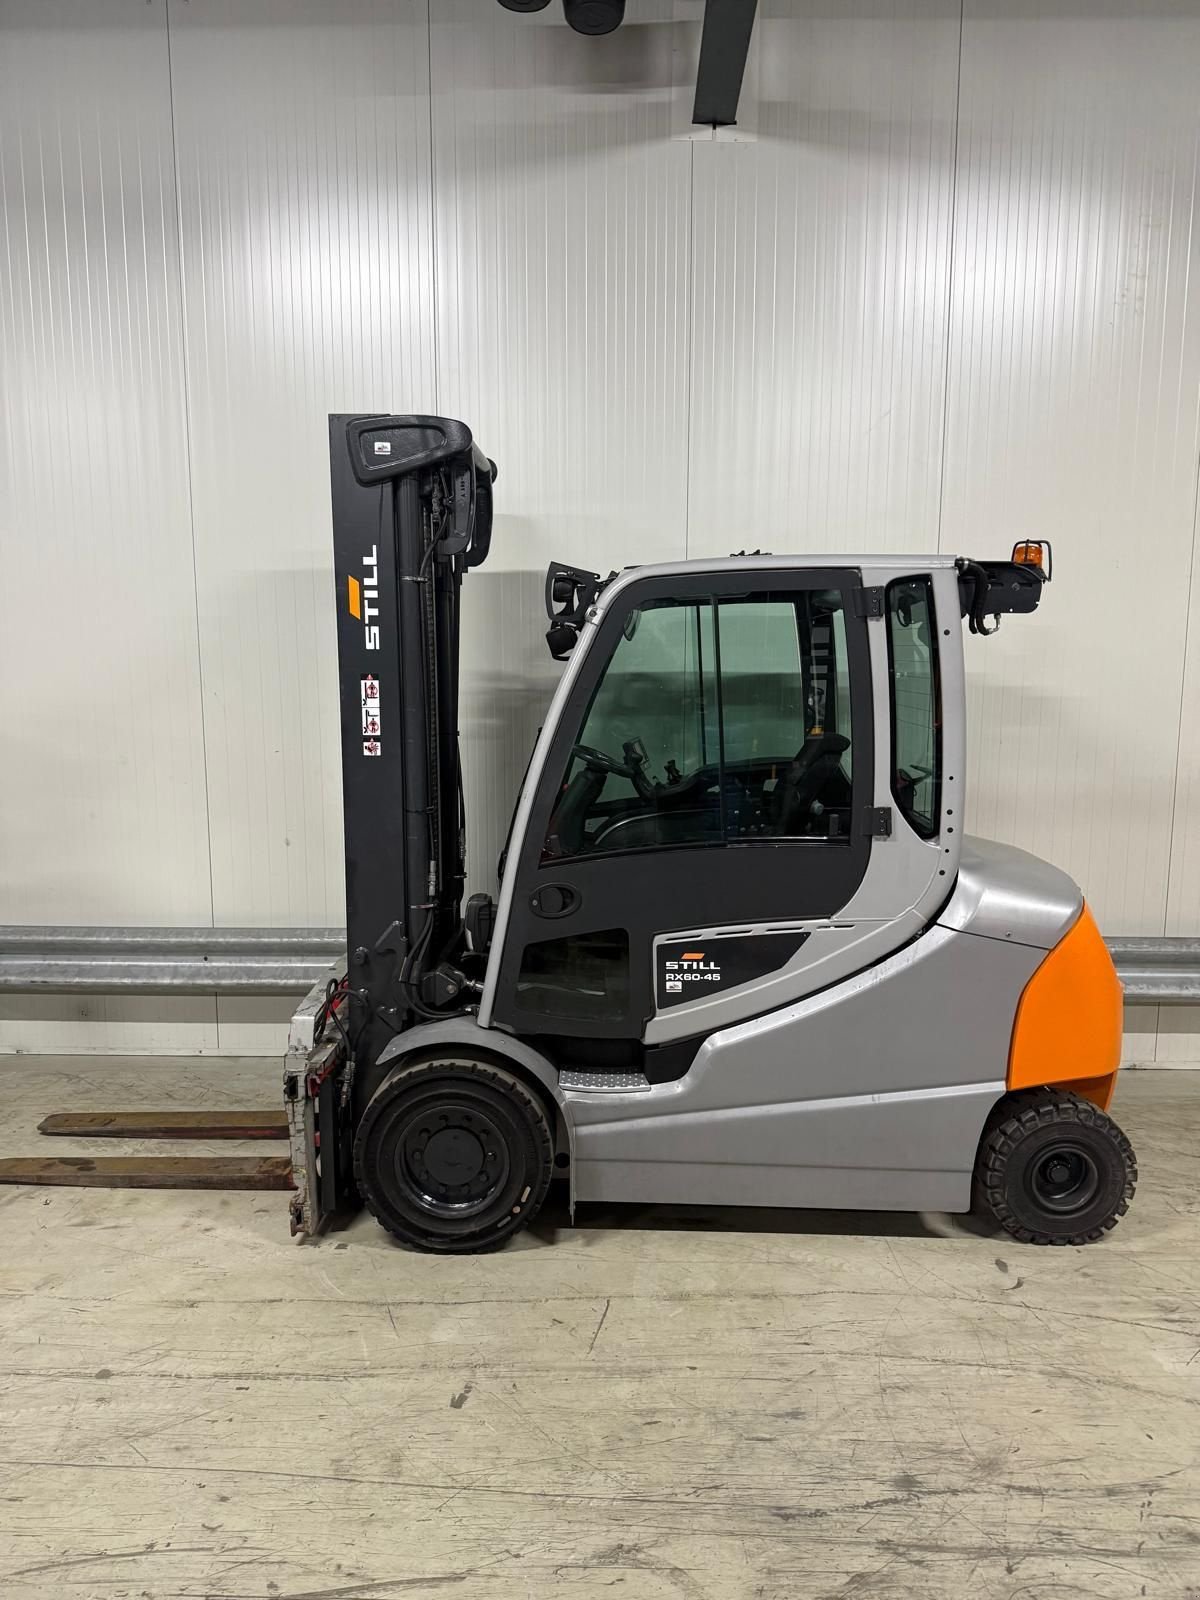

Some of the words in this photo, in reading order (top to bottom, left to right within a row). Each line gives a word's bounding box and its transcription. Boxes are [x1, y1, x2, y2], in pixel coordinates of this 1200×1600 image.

[363, 544, 380, 650] STILL
[666, 961, 721, 970] STILL
[666, 973, 721, 981] RX60-45
